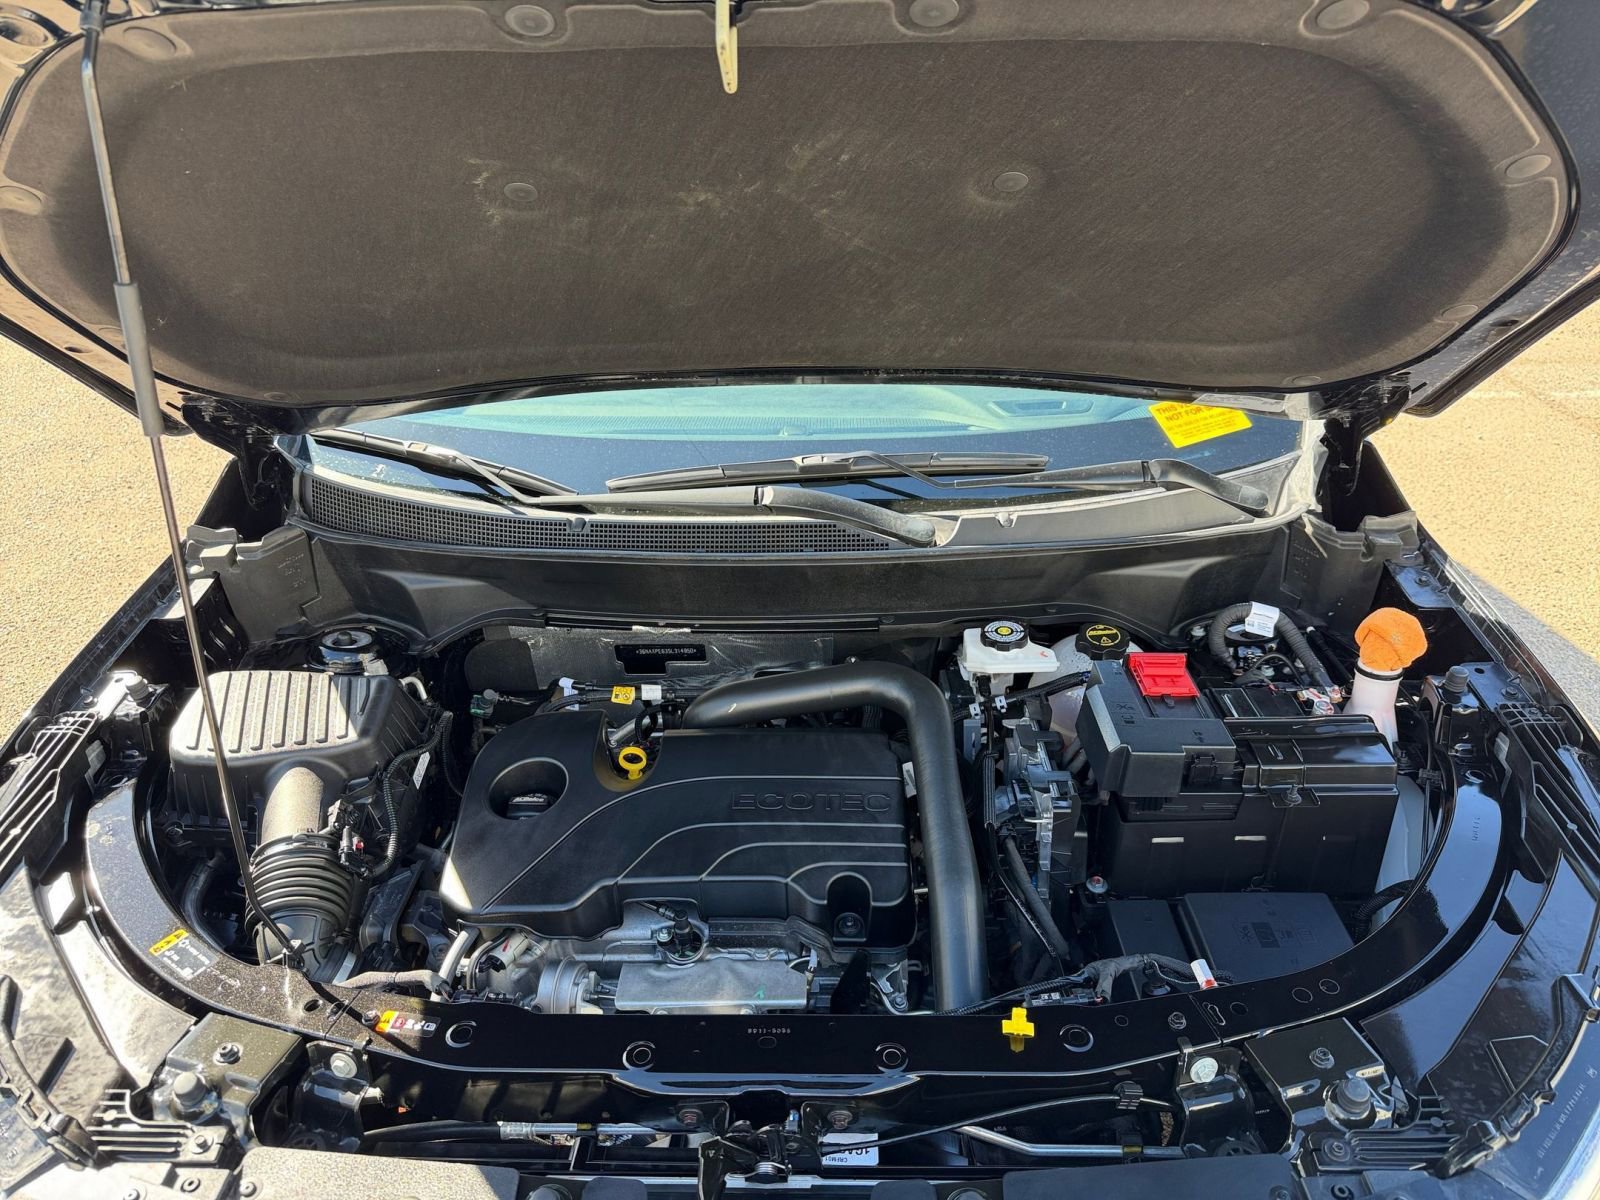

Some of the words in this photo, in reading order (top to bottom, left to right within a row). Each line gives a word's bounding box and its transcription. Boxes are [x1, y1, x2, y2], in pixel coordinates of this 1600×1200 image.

[1155, 404, 1178, 415] THIS
[1165, 411, 1184, 422] NOT
[1184, 406, 1203, 416] FOR
[731, 792, 891, 812] ECOTEC
